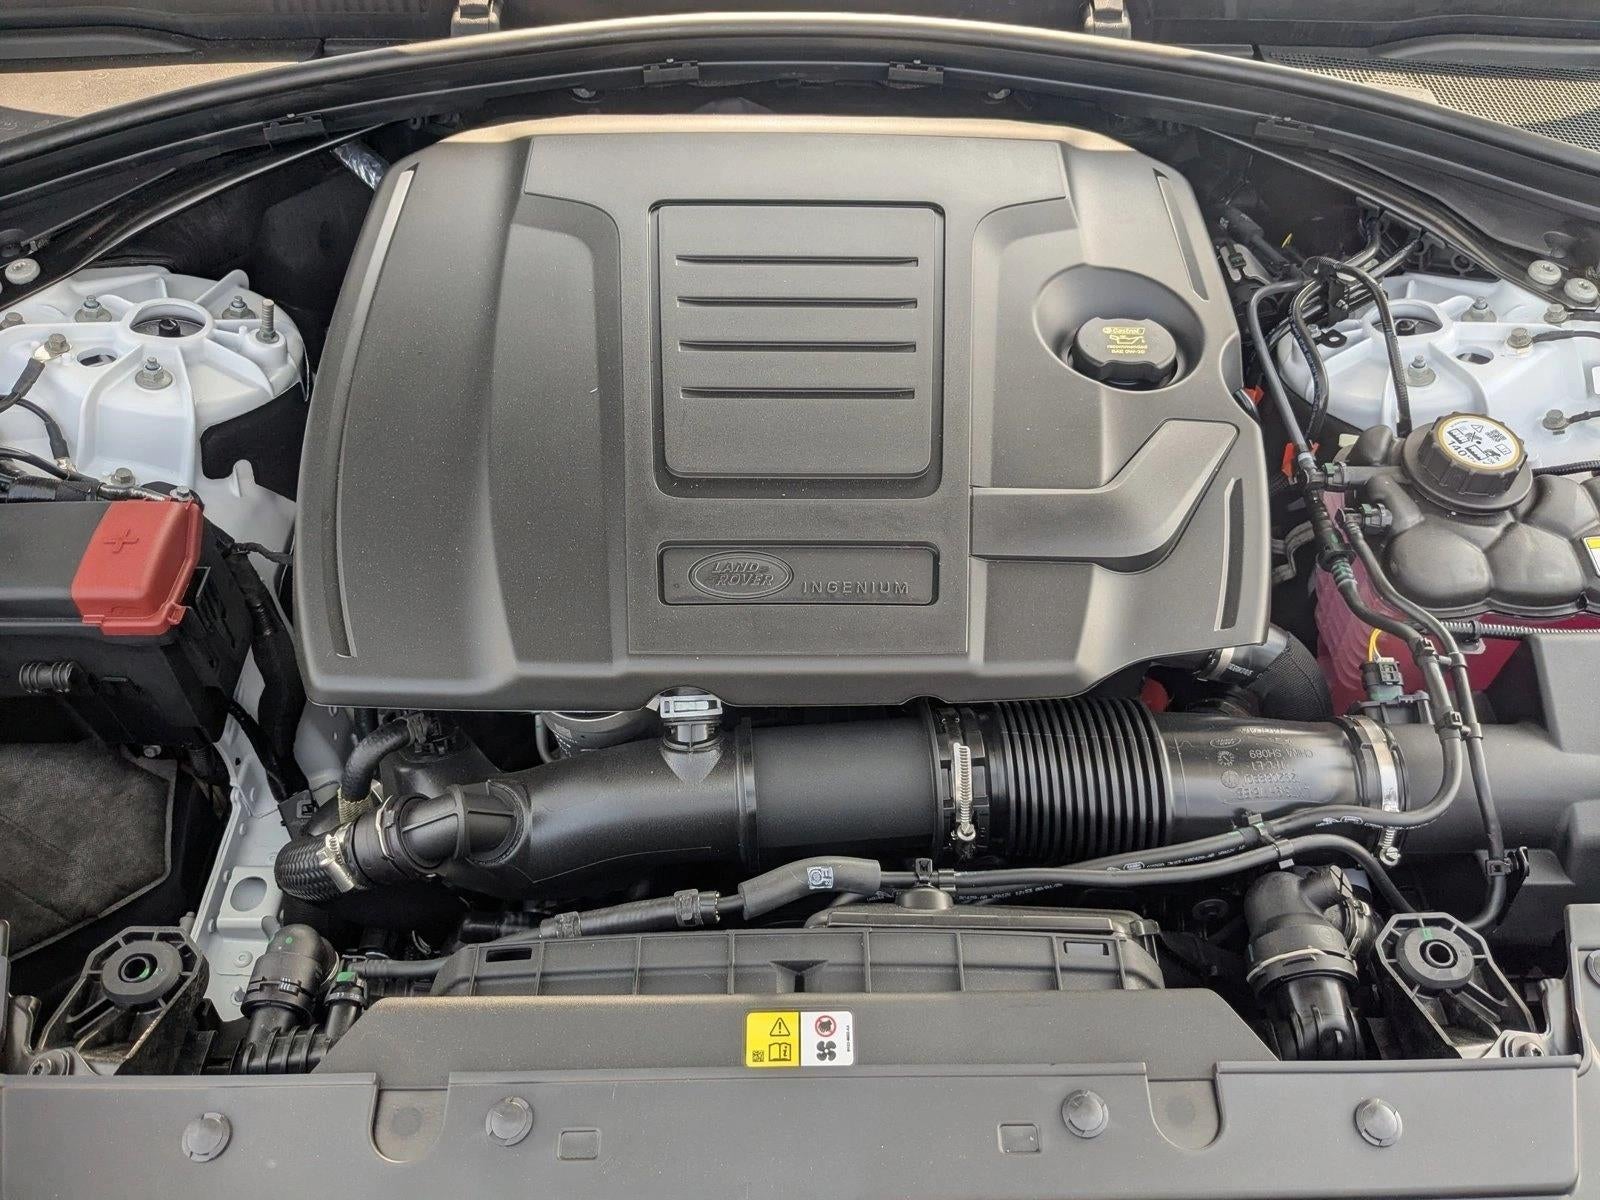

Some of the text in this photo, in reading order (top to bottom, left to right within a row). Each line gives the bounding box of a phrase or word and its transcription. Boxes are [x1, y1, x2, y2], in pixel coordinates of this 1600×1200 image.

[1447, 440, 1468, 458] 140
[711, 561, 761, 574] LAND
[715, 573, 775, 587] ROVER
[802, 580, 910, 595] INGENIUM
